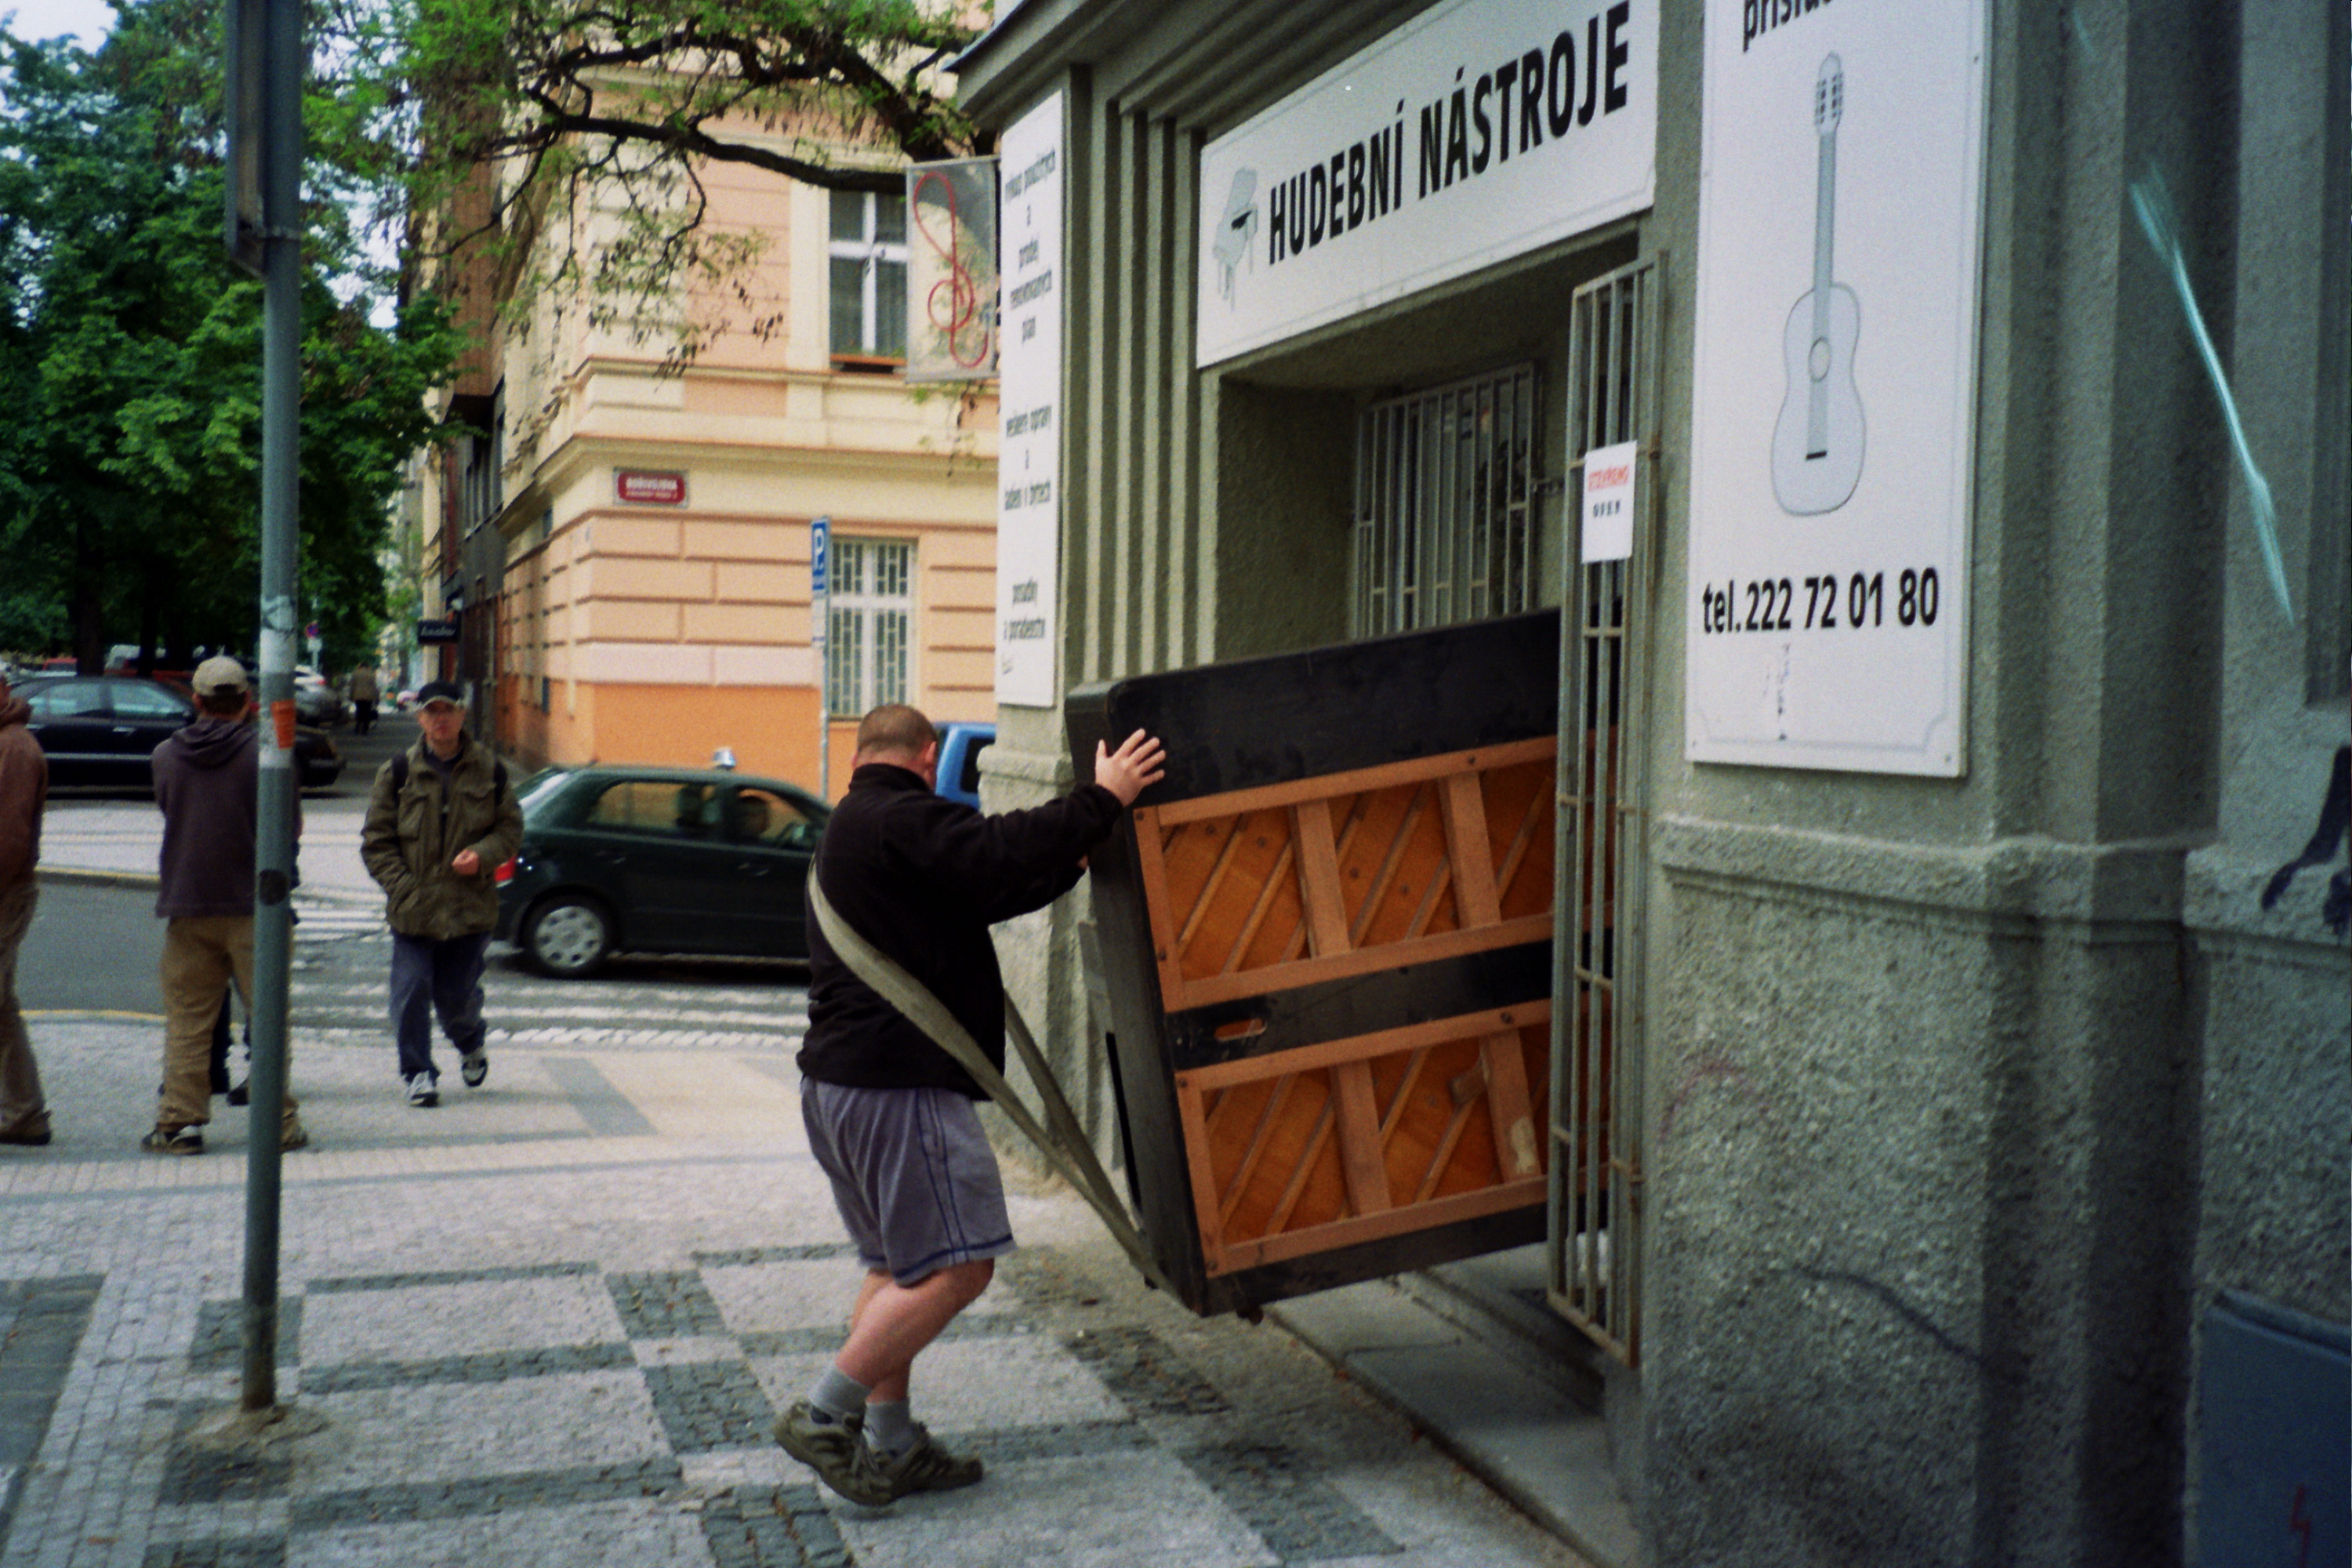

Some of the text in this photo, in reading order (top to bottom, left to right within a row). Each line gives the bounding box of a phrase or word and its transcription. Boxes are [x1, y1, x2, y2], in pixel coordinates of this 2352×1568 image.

[1269, 0, 1630, 265] HUDEBNÍ NÁSTROJE
[1804, 574, 1838, 630] 72
[1848, 570, 1885, 630] 01
[1897, 565, 1940, 628] 80
